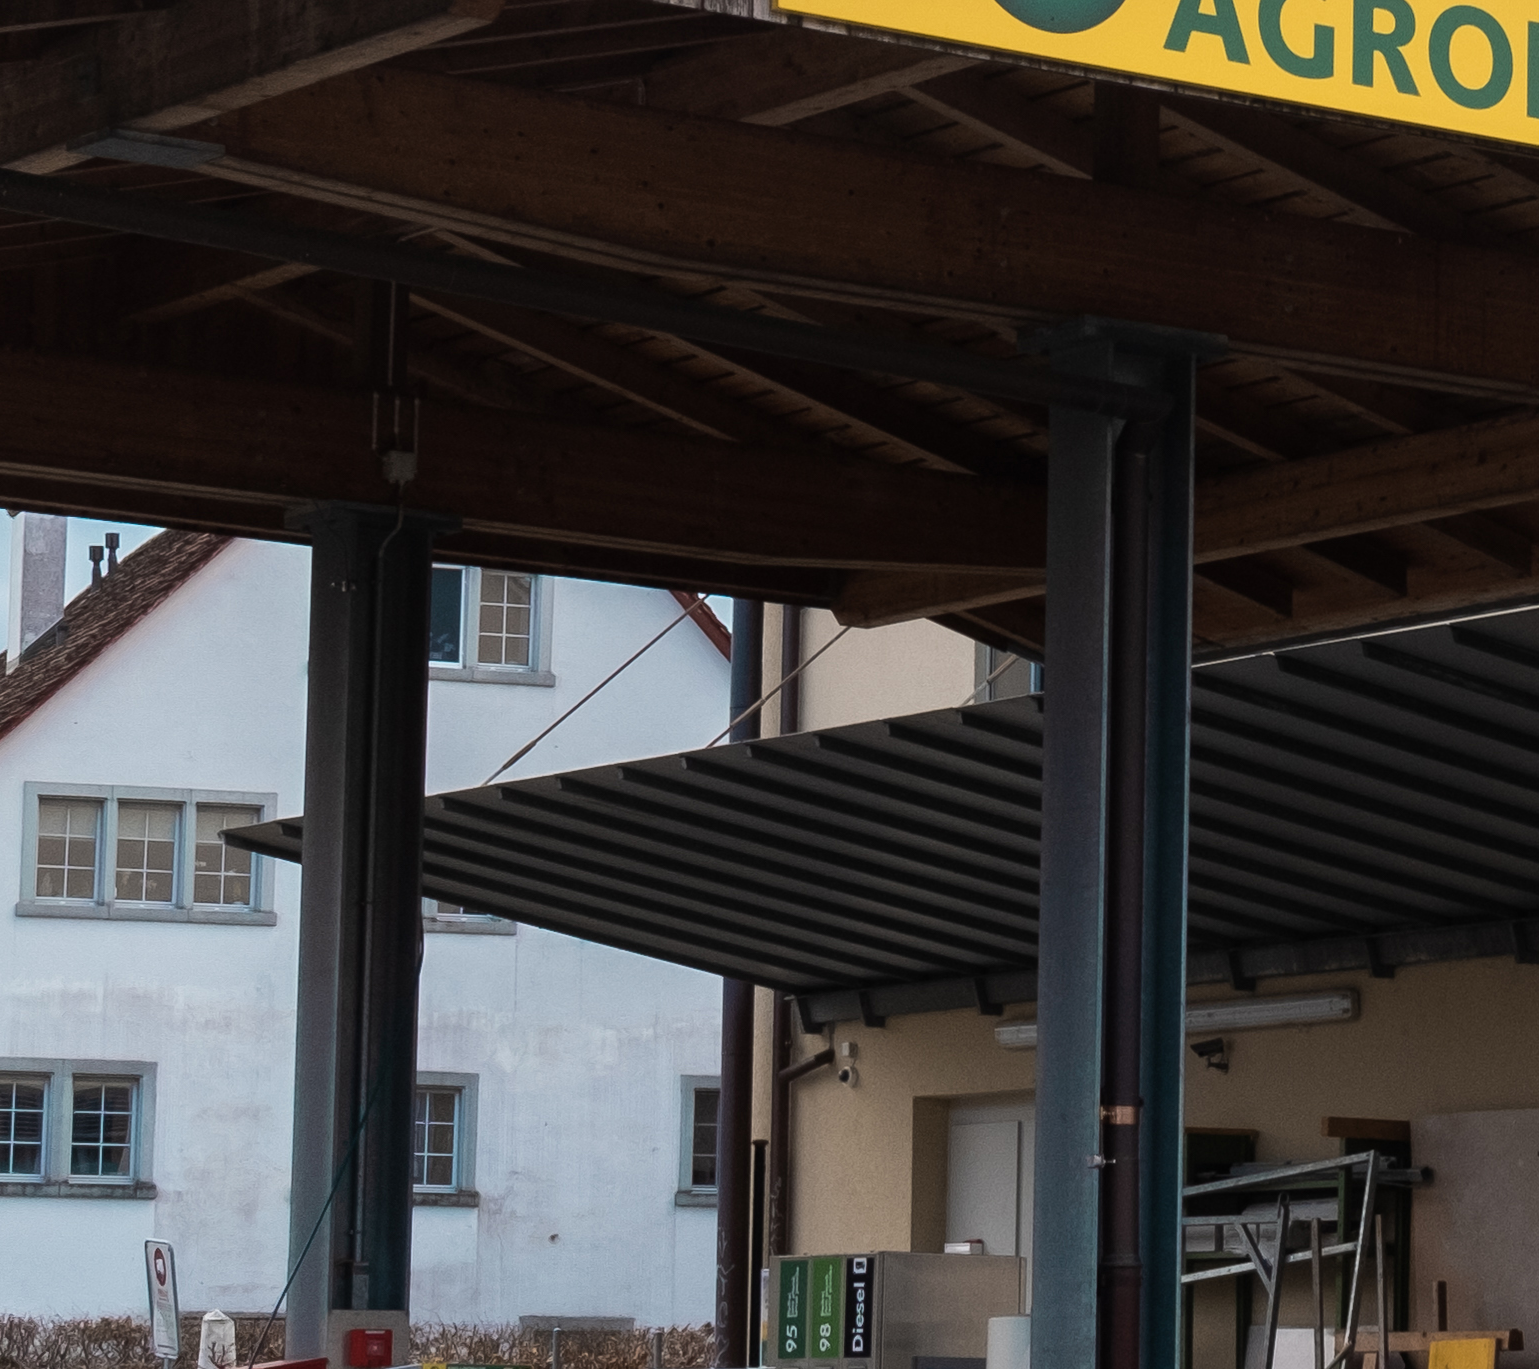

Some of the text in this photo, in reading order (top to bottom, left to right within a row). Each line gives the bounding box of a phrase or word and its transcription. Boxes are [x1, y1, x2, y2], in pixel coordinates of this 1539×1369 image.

[851, 1281, 866, 1353] Diesel
[785, 1324, 798, 1353] 95
[819, 1323, 832, 1352] 98
